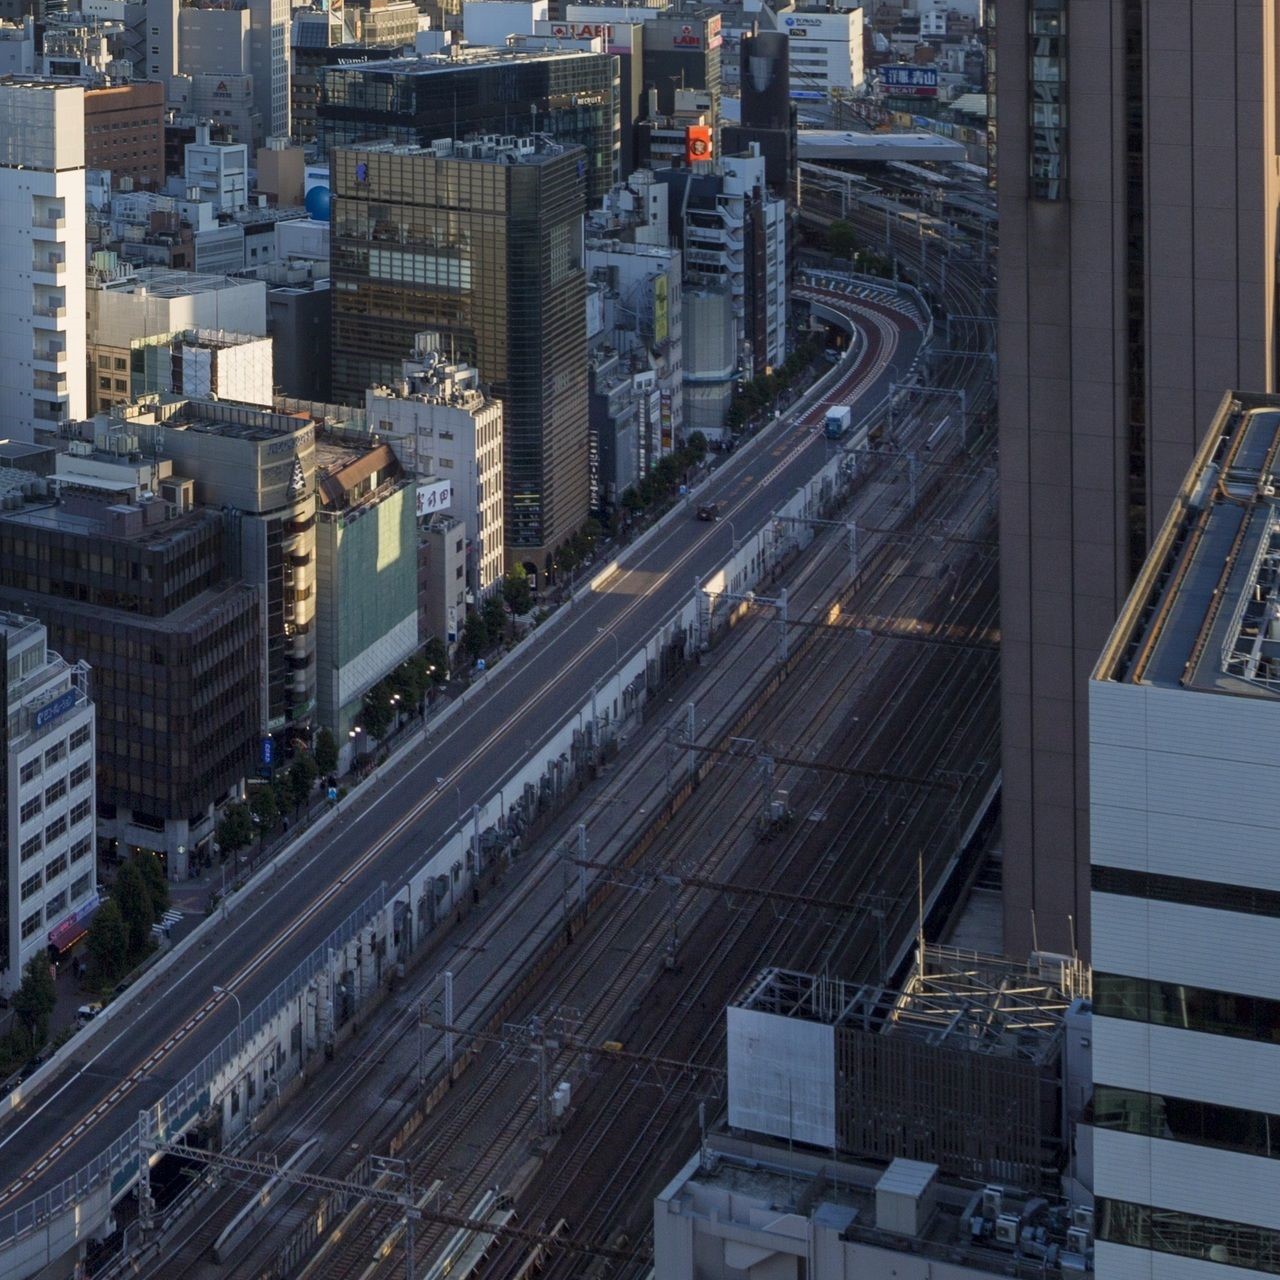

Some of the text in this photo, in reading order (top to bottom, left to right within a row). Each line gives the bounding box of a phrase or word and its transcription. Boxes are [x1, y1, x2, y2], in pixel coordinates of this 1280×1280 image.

[570, 24, 613, 37] LABI
[673, 36, 700, 45] LABI
[577, 96, 603, 106] RECRUIT
